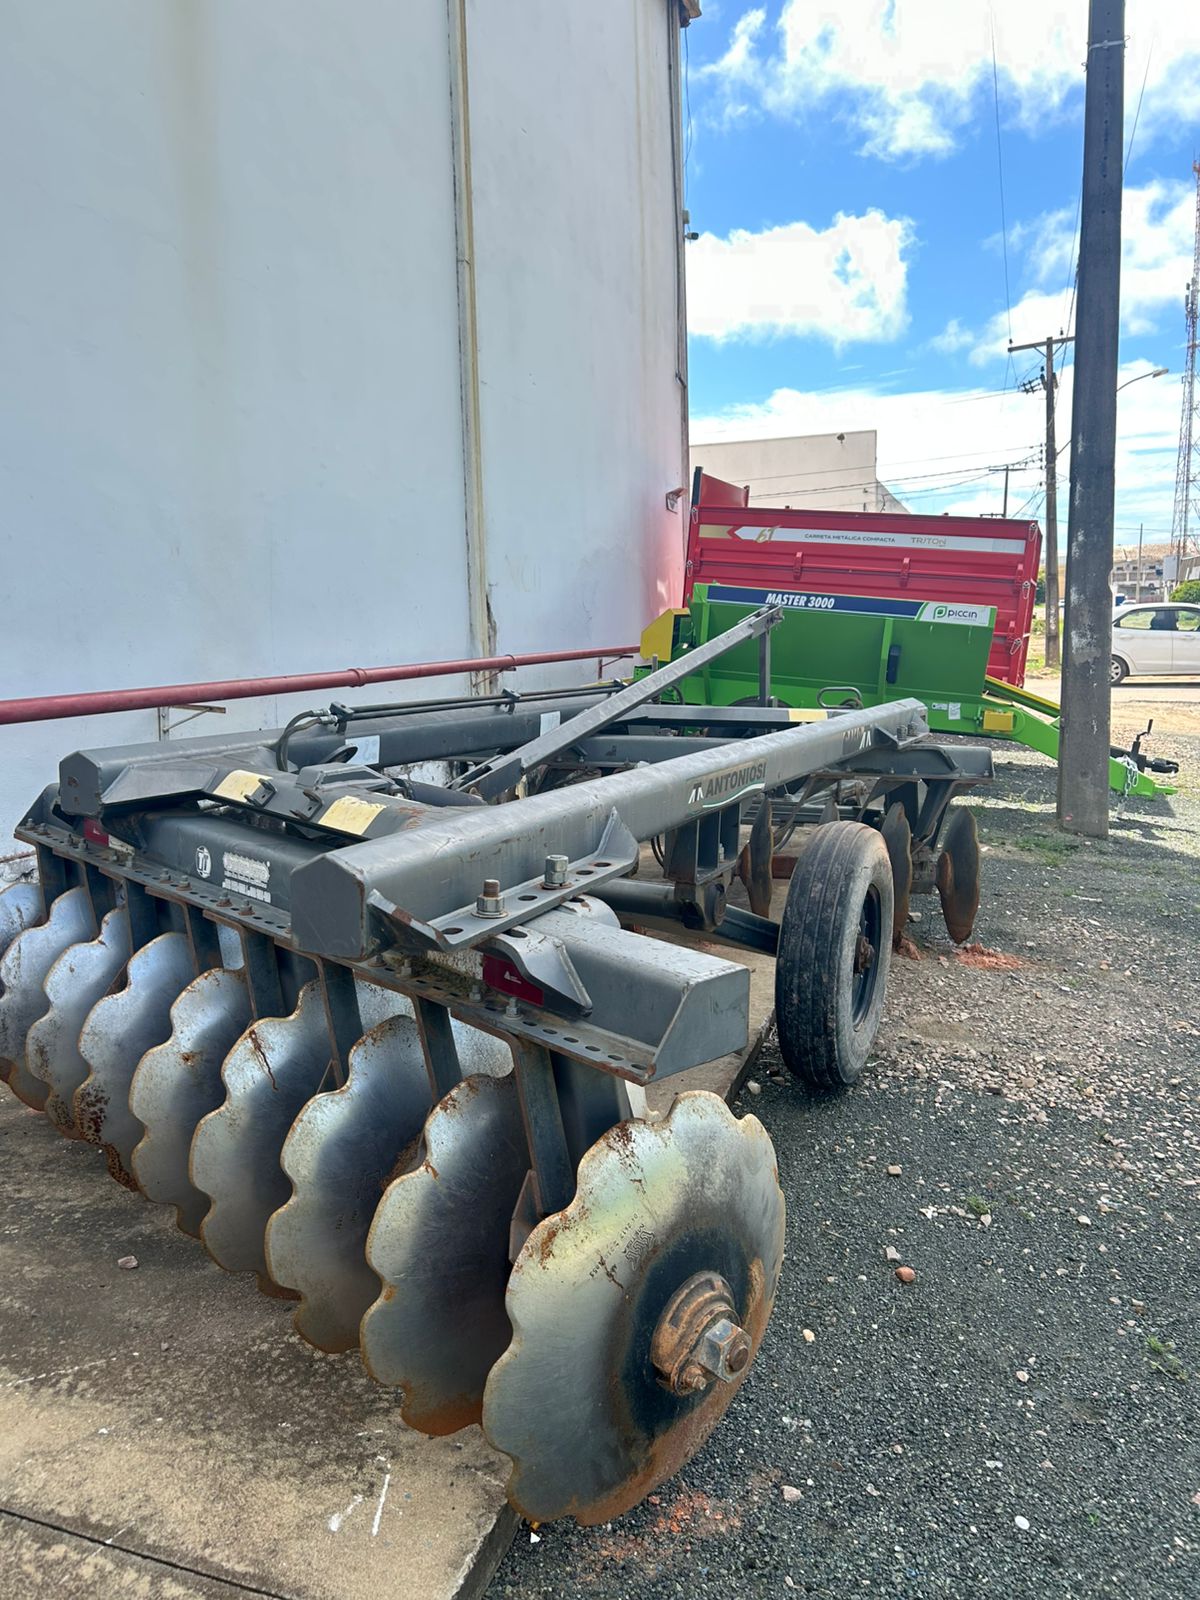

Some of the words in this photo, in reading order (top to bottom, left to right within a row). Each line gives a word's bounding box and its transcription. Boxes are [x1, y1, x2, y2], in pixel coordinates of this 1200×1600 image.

[911, 537, 947, 545] TRITON
[765, 593, 807, 606] MASTER
[808, 596, 835, 609] 3000
[947, 609, 978, 618] piccin
[706, 762, 767, 798] ANTONIOSI
